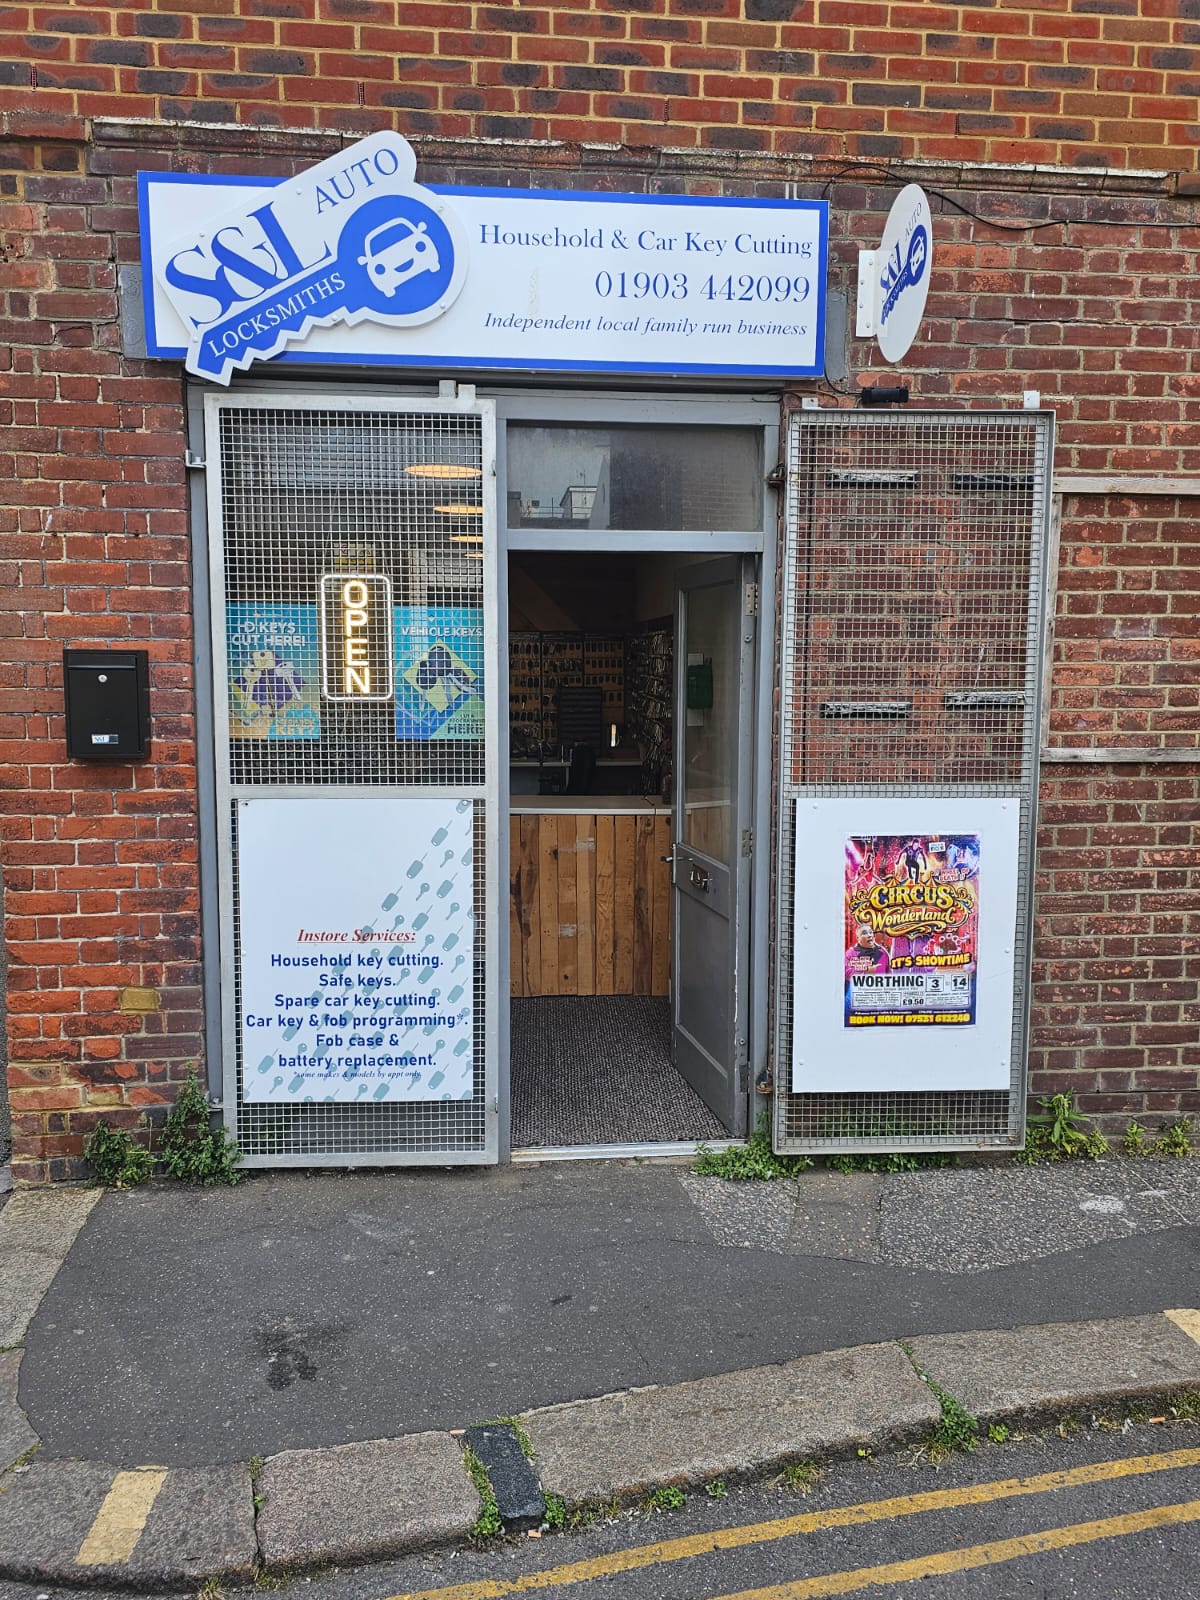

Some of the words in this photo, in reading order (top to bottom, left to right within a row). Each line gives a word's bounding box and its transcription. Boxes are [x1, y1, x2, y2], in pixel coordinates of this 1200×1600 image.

[314, 148, 399, 214] AUTO
[479, 223, 603, 249] Household
[611, 229, 630, 250] &
[638, 230, 678, 251] Car
[685, 231, 728, 257] Key
[734, 233, 813, 258] Cutting
[165, 201, 332, 325] S&L
[595, 270, 688, 300] 01903
[700, 273, 810, 303] 442099
[207, 272, 346, 358] LOCKSMITHS
[484, 312, 591, 332] Independent
[597, 316, 640, 332] local
[641, 317, 698, 337] family
[703, 322, 732, 335] run
[737, 320, 808, 336] business
[260, 621, 296, 634] KEYS
[401, 626, 450, 637] VEHICLE
[453, 627, 483, 638] KEYS
[232, 634, 260, 646] CUT
[264, 635, 306, 647] HERE!
[343, 580, 371, 694] OPEN
[870, 885, 954, 909] CIRCUS
[861, 907, 956, 930] Wonderland
[296, 929, 349, 943] Instore
[352, 929, 416, 943] Services:
[271, 953, 352, 967] Household
[357, 954, 383, 970] key
[388, 953, 444, 969] cutting.
[891, 956, 912, 969] IT'S
[916, 953, 971, 968] SHOWTIME
[319, 974, 352, 987] Safe
[357, 974, 396, 989] keys.
[852, 975, 924, 988] WORTHING
[931, 979, 940, 988] 3
[952, 978, 967, 987] 14
[274, 994, 320, 1010] Spare
[325, 996, 349, 1007] car
[354, 994, 380, 1010] key
[385, 993, 440, 1009] cutting.
[246, 1014, 273, 1027] Car
[278, 1014, 304, 1030] key
[308, 1014, 320, 1027] &
[324, 1013, 348, 1027] fob
[849, 1015, 876, 1024] BOOK
[316, 1034, 343, 1047] Fob
[349, 1036, 384, 1047] case
[389, 1033, 400, 1047] &
[279, 1054, 333, 1069] battery
[337, 1053, 437, 1069] replacement.
